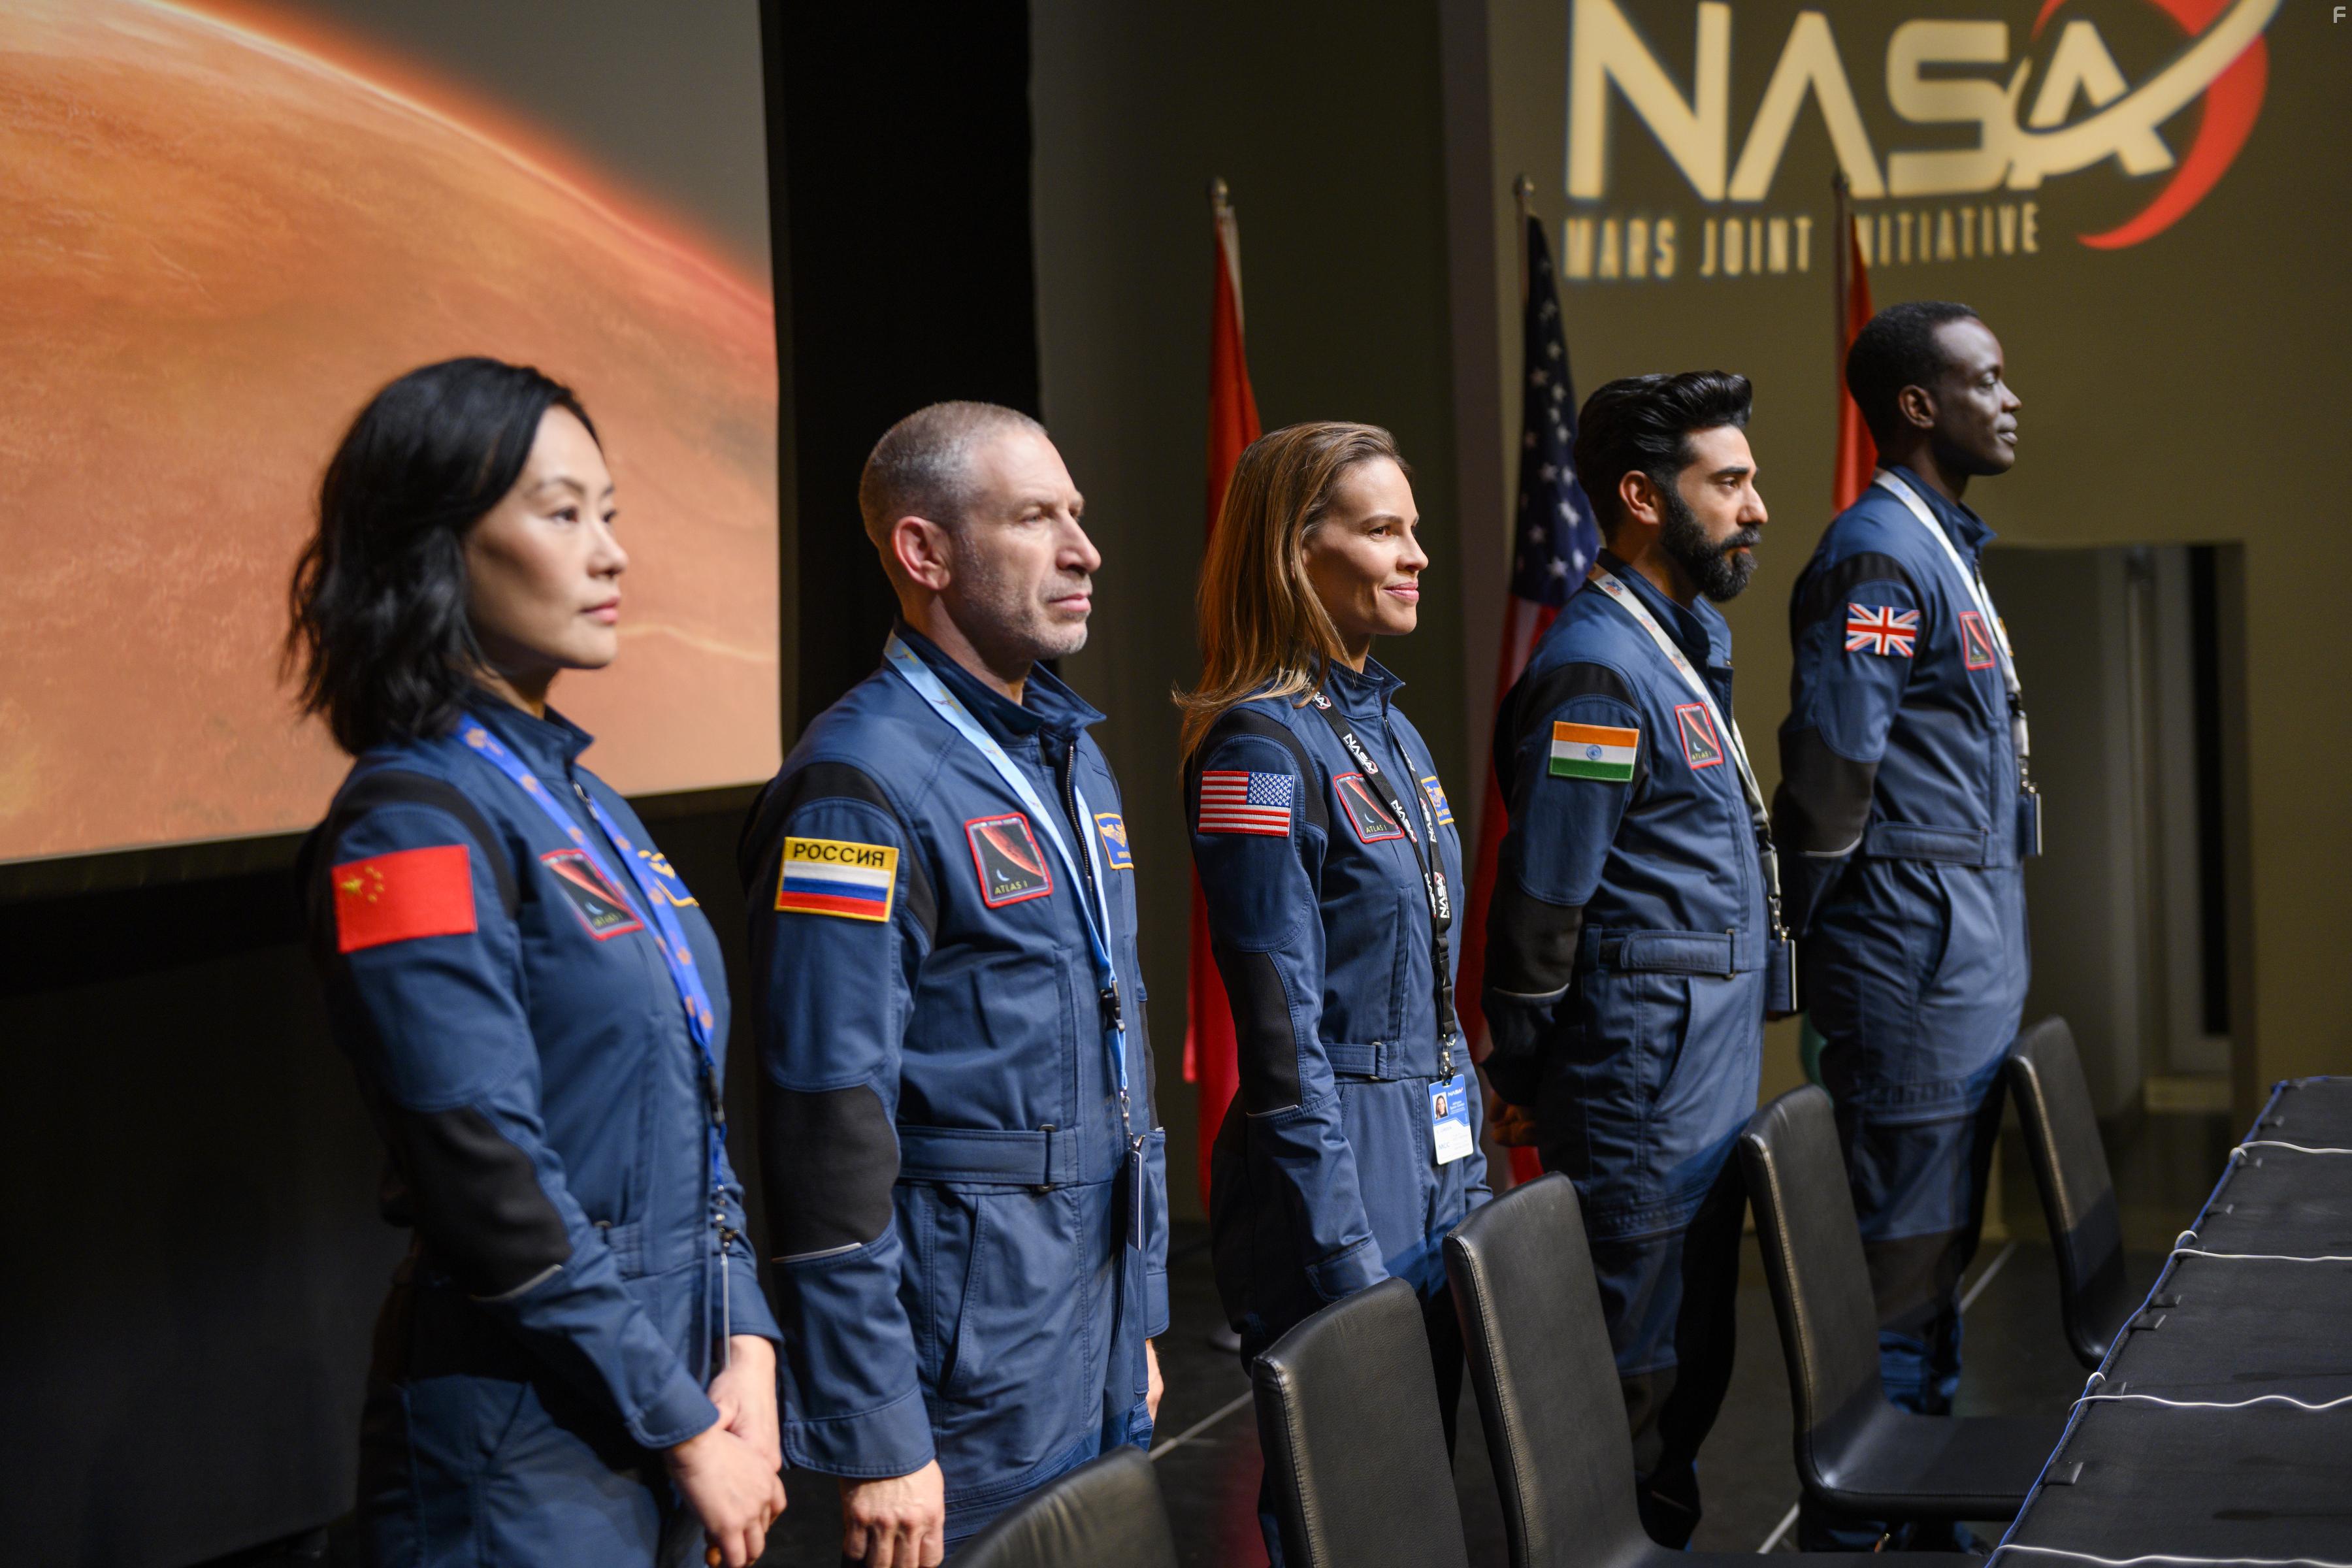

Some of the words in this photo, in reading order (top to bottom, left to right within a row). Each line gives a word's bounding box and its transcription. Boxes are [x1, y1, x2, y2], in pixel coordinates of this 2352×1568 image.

[1566, 0, 2177, 201] NASA
[1565, 218, 1675, 278] MARS
[1700, 217, 1813, 276] JOINT
[1854, 203, 2039, 269] NITIATIVE
[1343, 733, 1377, 774] NASA
[1366, 825, 1384, 834] ATLAS
[794, 843, 885, 867] РОССИЯ
[994, 881, 1022, 895] ATLAS
[1435, 872, 1447, 918] NASA
